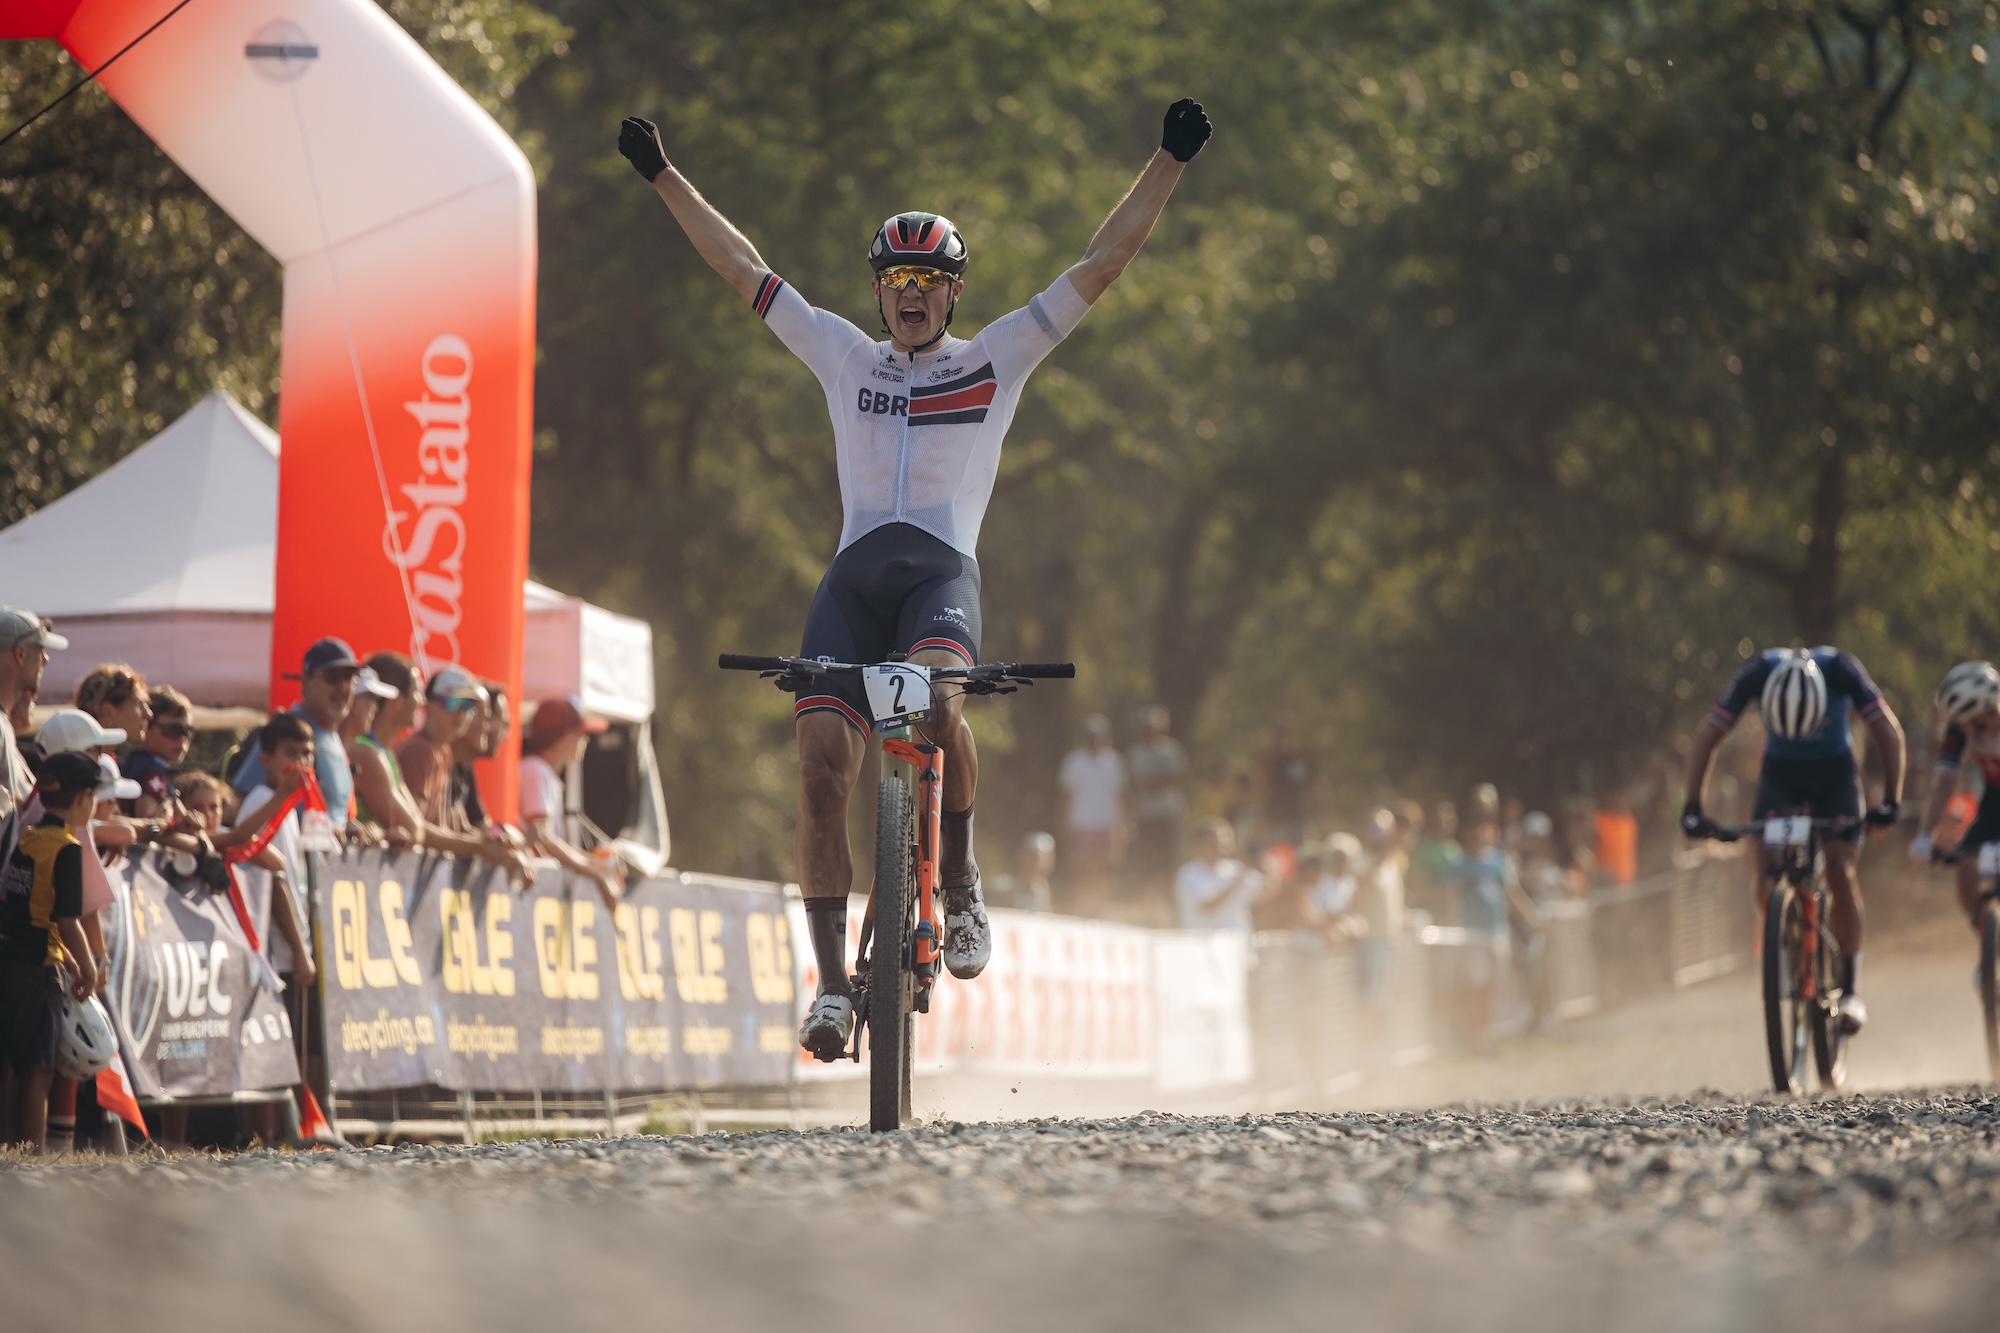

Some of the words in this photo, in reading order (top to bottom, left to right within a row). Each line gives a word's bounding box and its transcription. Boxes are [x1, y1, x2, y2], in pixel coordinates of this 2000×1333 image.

[857, 387, 908, 417] GBR
[933, 615, 970, 632] LLOYDS
[889, 674, 907, 715] 2
[160, 940, 233, 1019] UEC
